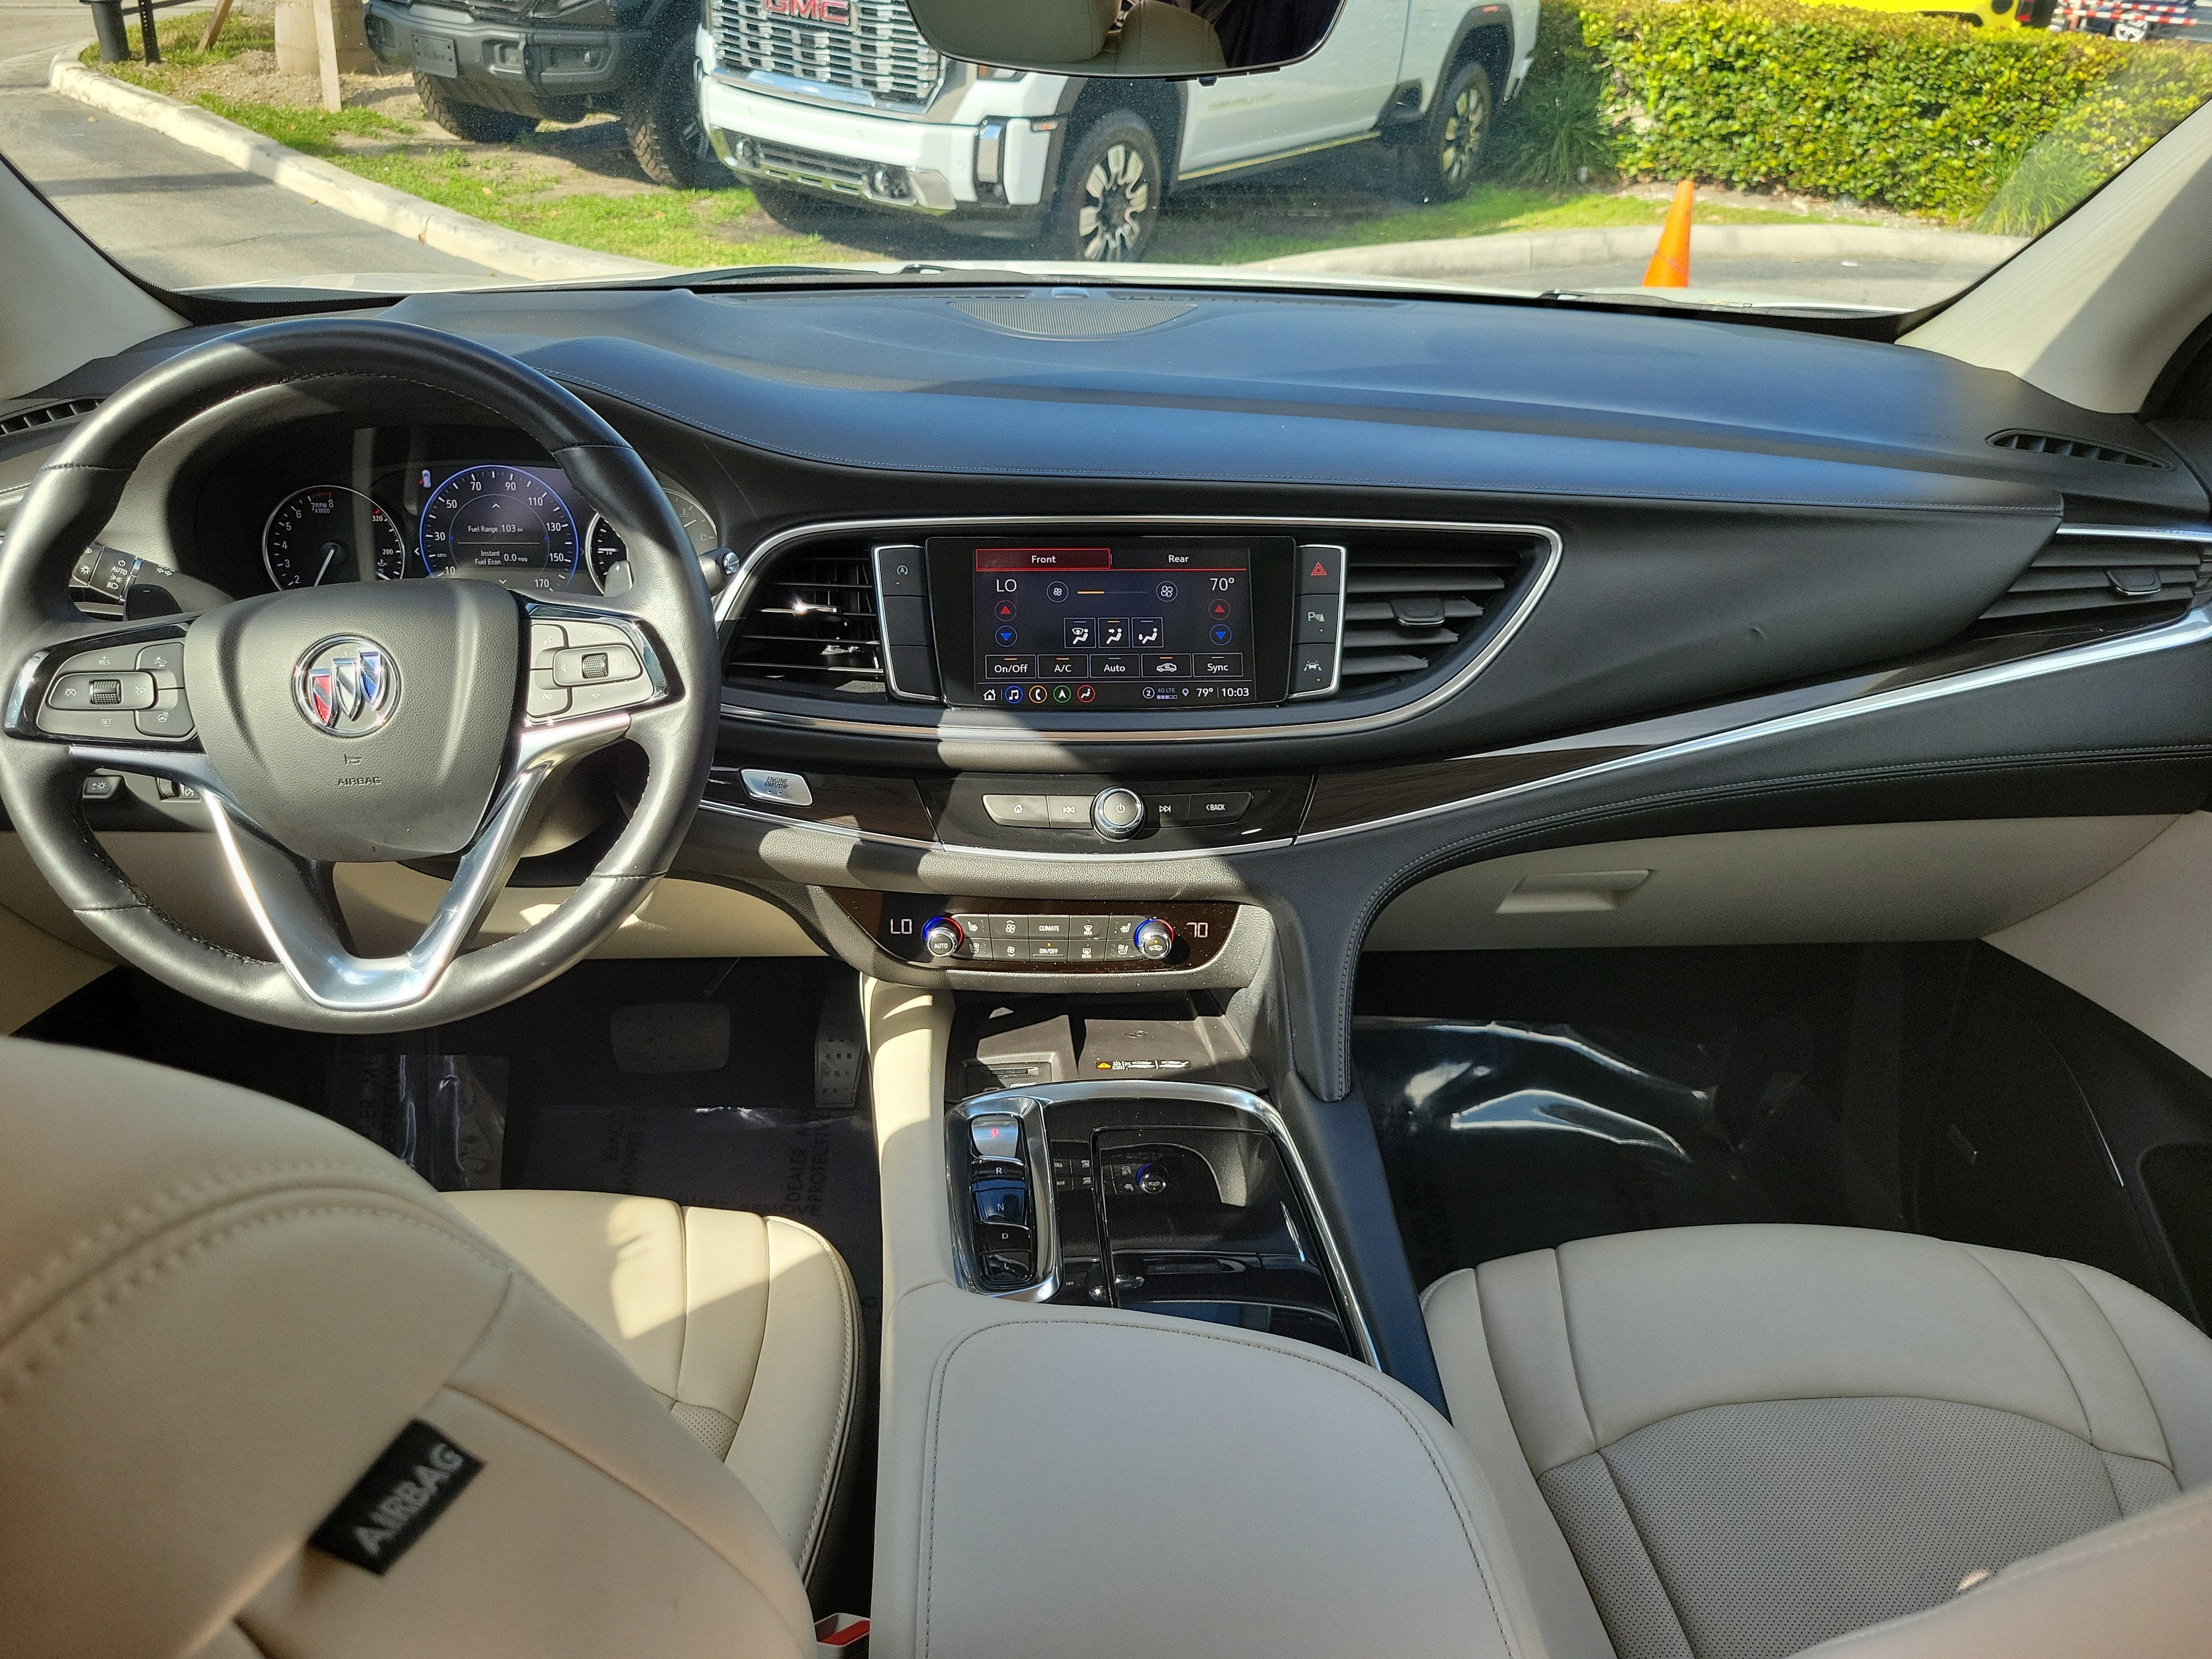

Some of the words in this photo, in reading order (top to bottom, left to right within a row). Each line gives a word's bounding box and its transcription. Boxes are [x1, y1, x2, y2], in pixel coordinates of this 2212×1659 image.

[470, 482, 482, 490] 70
[505, 482, 516, 490] 90
[329, 499, 334, 507] 8
[446, 500, 457, 509] 50
[528, 497, 543, 506] 110
[296, 510, 301, 518] 6
[286, 522, 291, 531] 5
[501, 524, 516, 533] 103
[546, 523, 561, 532] 130
[435, 532, 445, 540] 30
[282, 541, 287, 549] 4
[504, 554, 517, 562] 0.0
[549, 553, 564, 562] 150
[1168, 555, 1189, 563] Rear
[285, 559, 290, 568] 3
[111, 566, 128, 575] AUTO
[445, 566, 455, 575] 10
[294, 575, 300, 584] 2
[535, 579, 549, 588] 170
[1209, 577, 1235, 591] 70°
[996, 579, 1017, 592] LO
[994, 664, 1028, 673] On/Off
[1054, 664, 1072, 673] A/C
[1104, 664, 1126, 673] Auto
[1207, 663, 1229, 673] Sync
[1196, 687, 1214, 697] 79°
[1221, 687, 1250, 697] 10:03
[338, 777, 382, 786] AIRBAG
[766, 776, 788, 785] ENGINE
[890, 918, 912, 934] LO
[1186, 922, 1207, 938] 70
[991, 1128, 998, 1138] P
[997, 1203, 1005, 1211] N
[353, 1443, 464, 1555] AIRBAG
